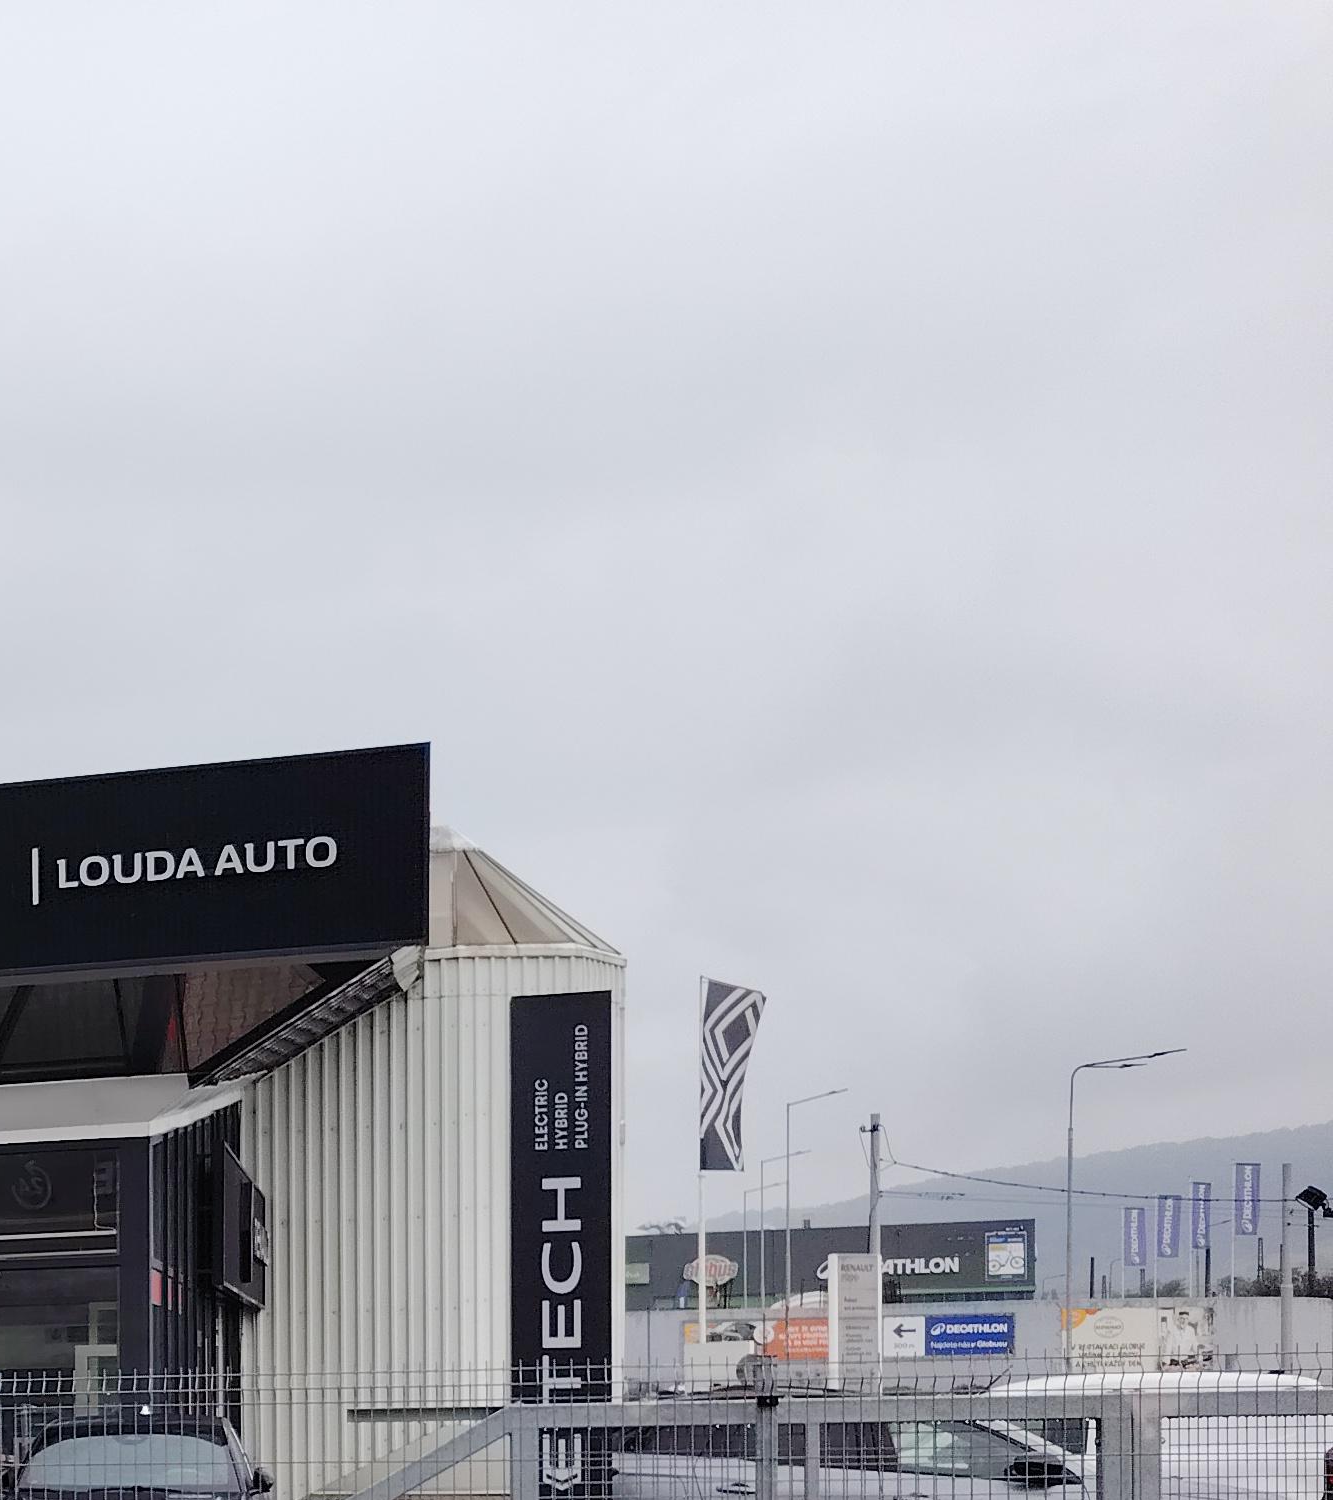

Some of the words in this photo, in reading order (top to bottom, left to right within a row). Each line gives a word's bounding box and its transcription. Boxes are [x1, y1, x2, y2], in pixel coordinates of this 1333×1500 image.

[56, 848, 206, 889] LOUDA
[214, 836, 338, 876] AUTO
[575, 1024, 588, 1082] HYBRID
[535, 1078, 548, 1151] ELECTRIC
[555, 1092, 568, 1150] HYBRID
[575, 1085, 588, 1149] PLUG-IN
[946, 1323, 1008, 1334] DECATHLON
